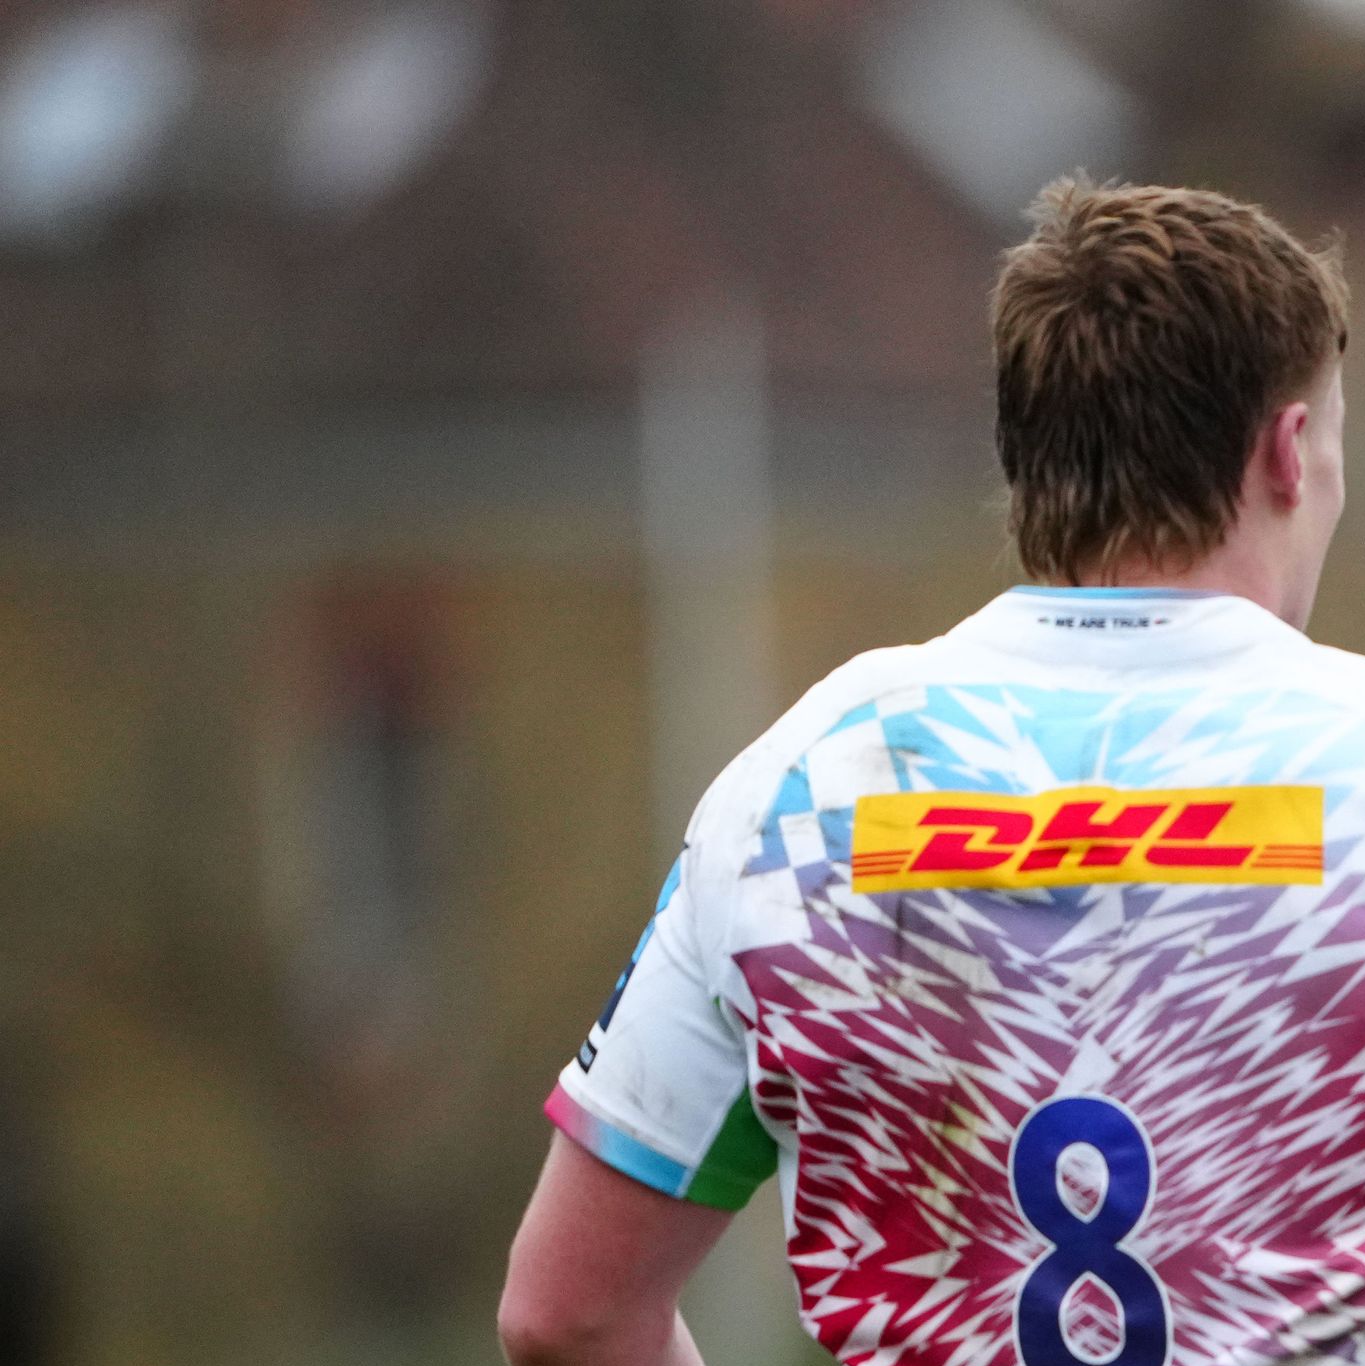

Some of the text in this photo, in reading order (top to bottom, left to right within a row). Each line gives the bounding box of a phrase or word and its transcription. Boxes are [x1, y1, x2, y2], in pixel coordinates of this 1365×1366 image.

[1056, 617, 1150, 629] WE ARE TRUE
[908, 801, 1256, 872] DHL
